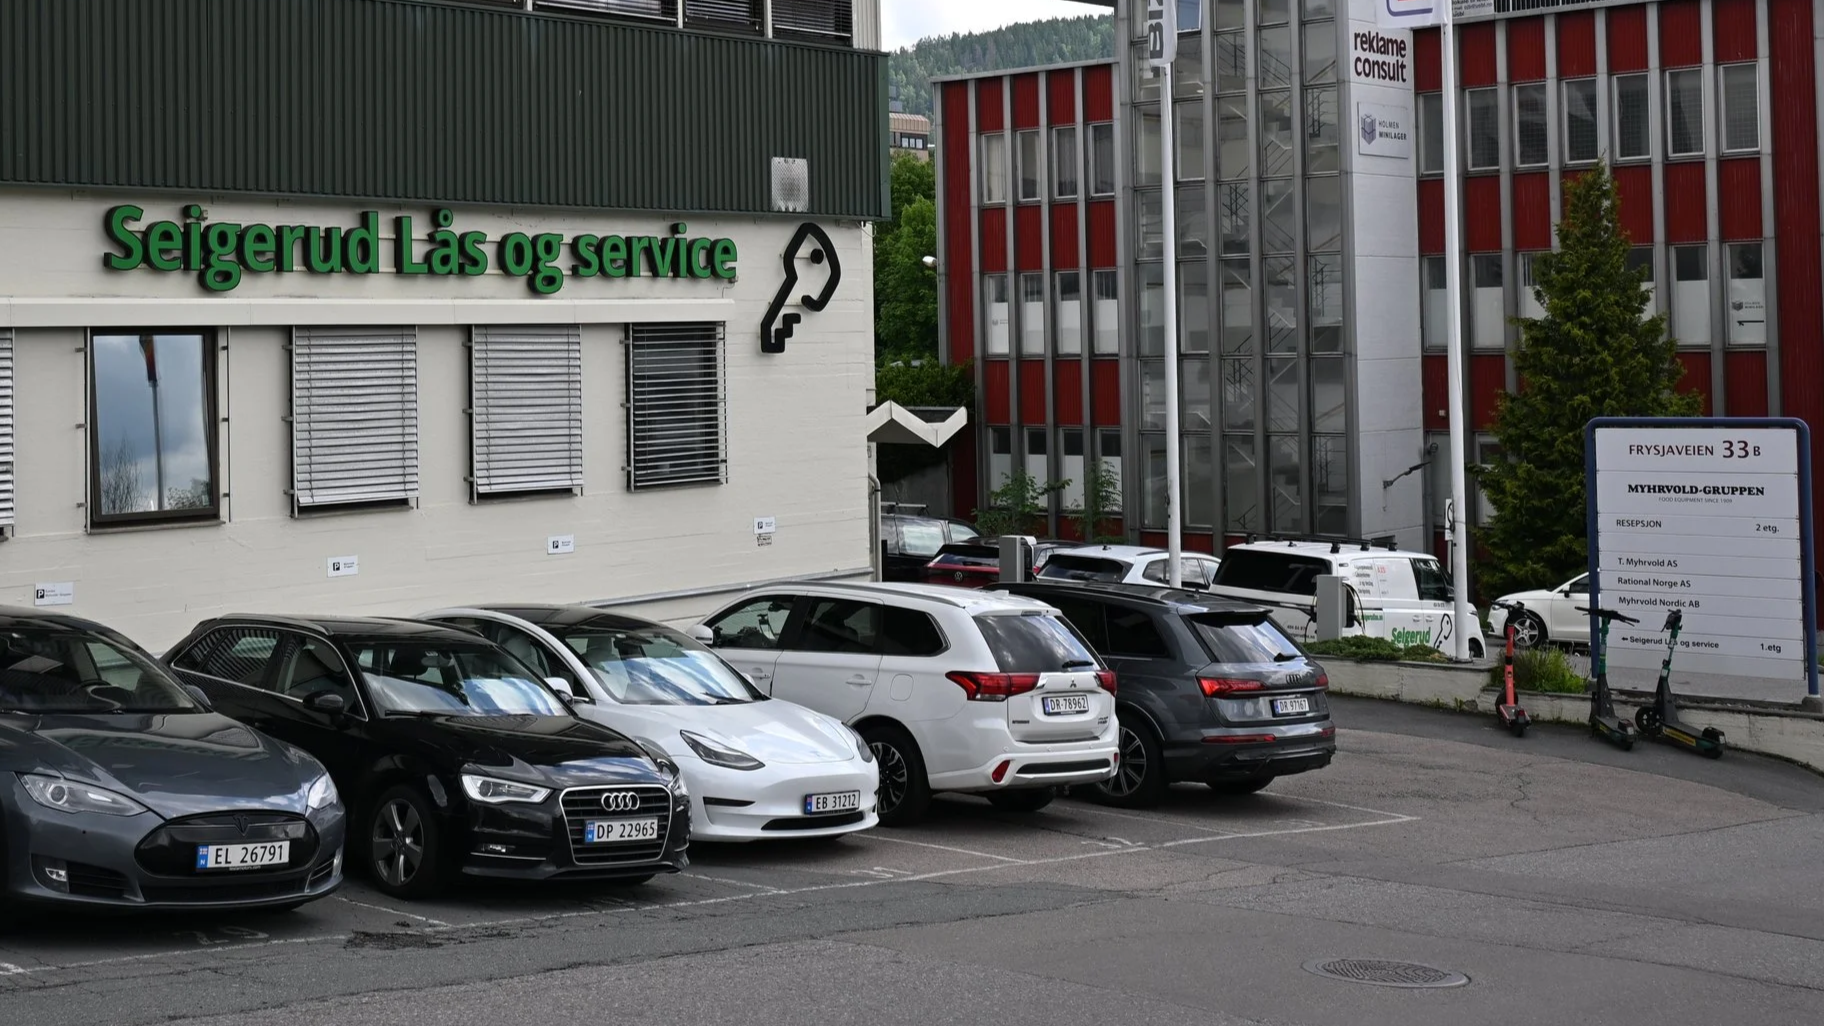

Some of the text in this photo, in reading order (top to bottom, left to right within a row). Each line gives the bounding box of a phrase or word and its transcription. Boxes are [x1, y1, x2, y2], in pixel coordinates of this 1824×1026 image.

[1354, 31, 1406, 58] reklame
[1354, 56, 1407, 83] consult
[1378, 119, 1400, 129] HOLMEN
[1378, 131, 1407, 141] MINILAGER
[103, 204, 738, 294] Seigerud Lås og service
[1629, 440, 1761, 458] FRYSJAVEIEN 33 B
[1628, 484, 1765, 496] MYHRVOLD-GRUPPEN
[1616, 519, 1779, 533] RESEPSJON 2 etg.
[1618, 557, 1678, 569] T. Myhrvold AS
[1617, 577, 1691, 588] Rational Norge AS
[37, 589, 44, 599] P
[1618, 596, 1700, 608] Myhrvold Nordic AB
[1391, 626, 1431, 648] Seigerud
[1629, 635, 1782, 653] Seigerud Ls og service 1.etg
[1064, 697, 1086, 710] 78962
[1280, 699, 1307, 711] DR 97167
[816, 794, 856, 809] EB 31212
[597, 824, 613, 839] DP
[619, 822, 655, 838] 22965
[215, 847, 231, 864] EL
[240, 844, 282, 864] 26791
